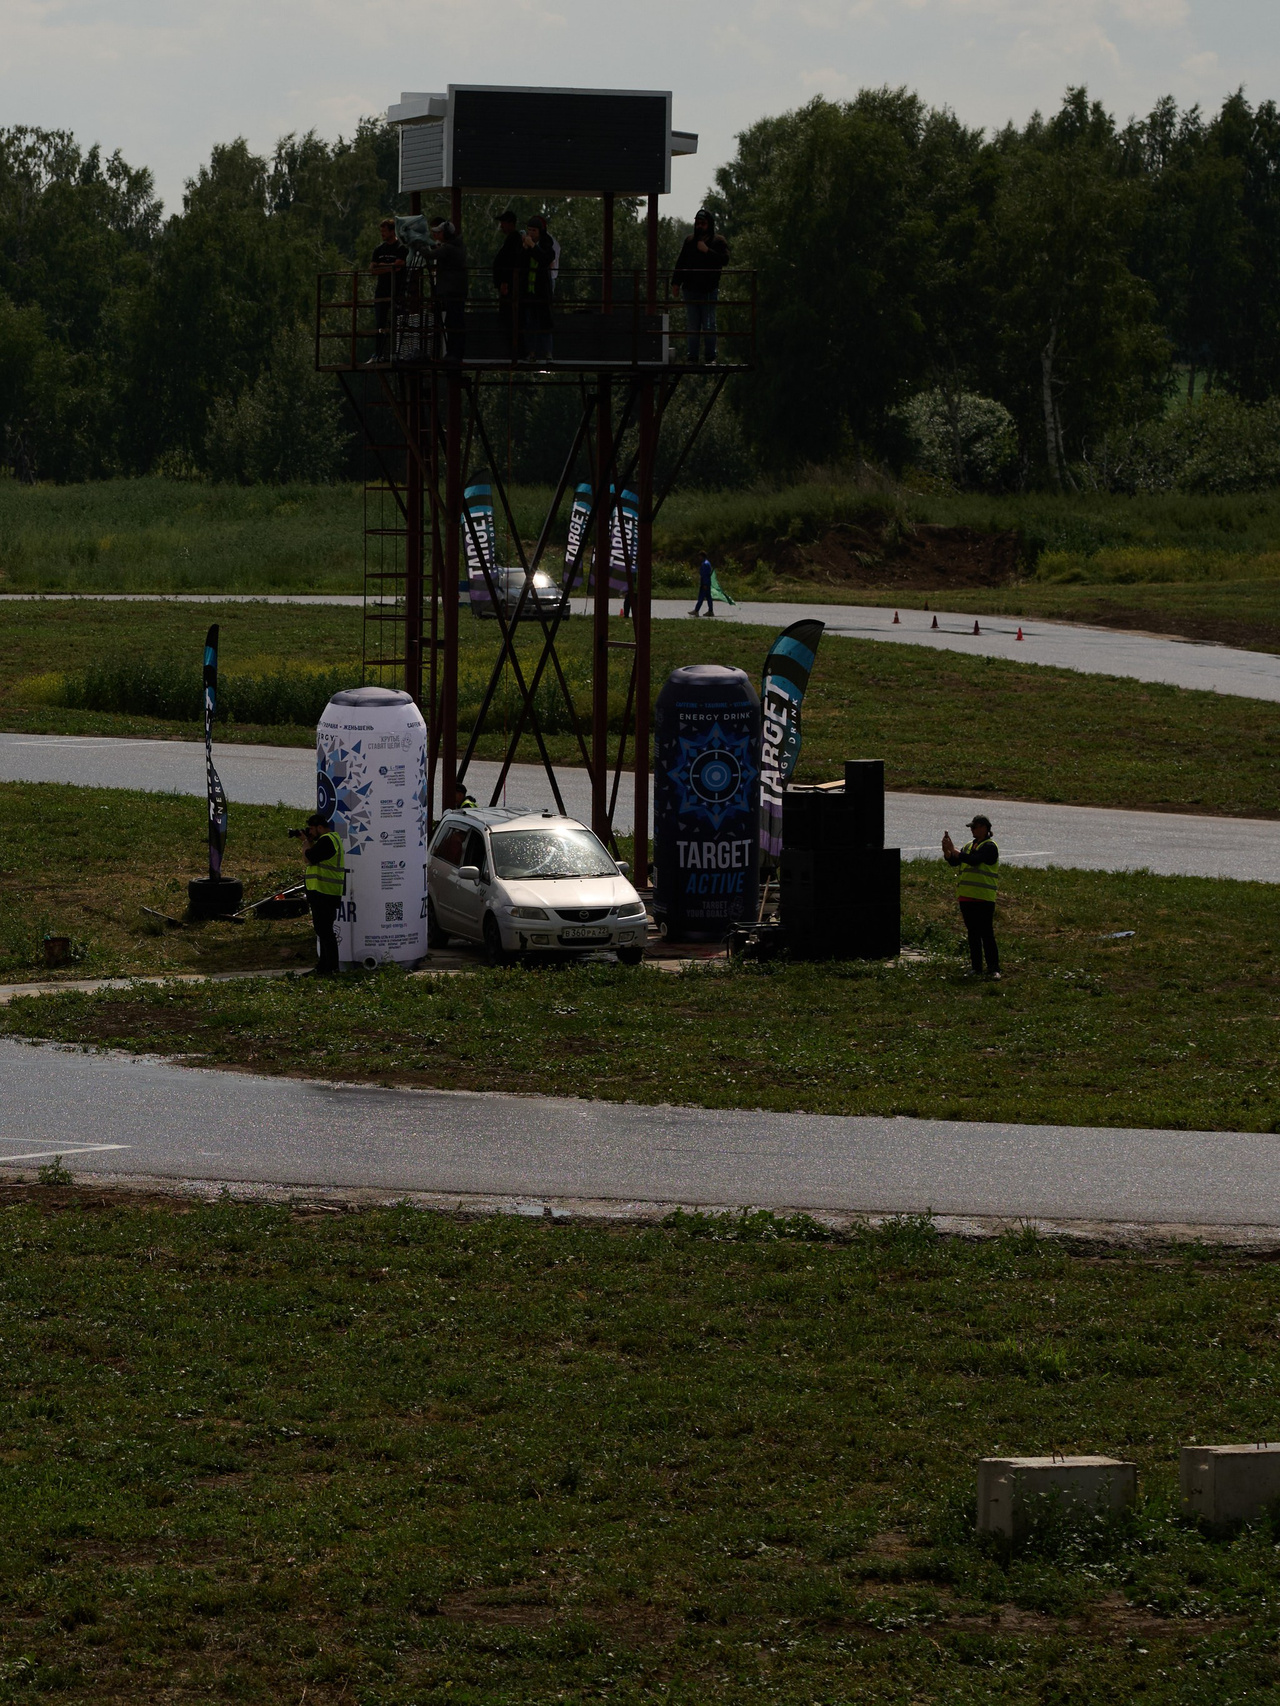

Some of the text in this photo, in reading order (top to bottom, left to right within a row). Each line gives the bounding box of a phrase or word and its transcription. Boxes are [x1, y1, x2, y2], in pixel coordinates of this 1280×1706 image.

[565, 501, 587, 562] TARGET
[679, 711, 750, 721] ENERGY DRINK
[788, 697, 799, 744] DRINK
[759, 675, 790, 807] TARGET
[676, 839, 753, 869] TARGET
[685, 871, 747, 895] ACTIVE
[686, 909, 729, 917] YOUR GOALS
[702, 901, 728, 909] TARGET
